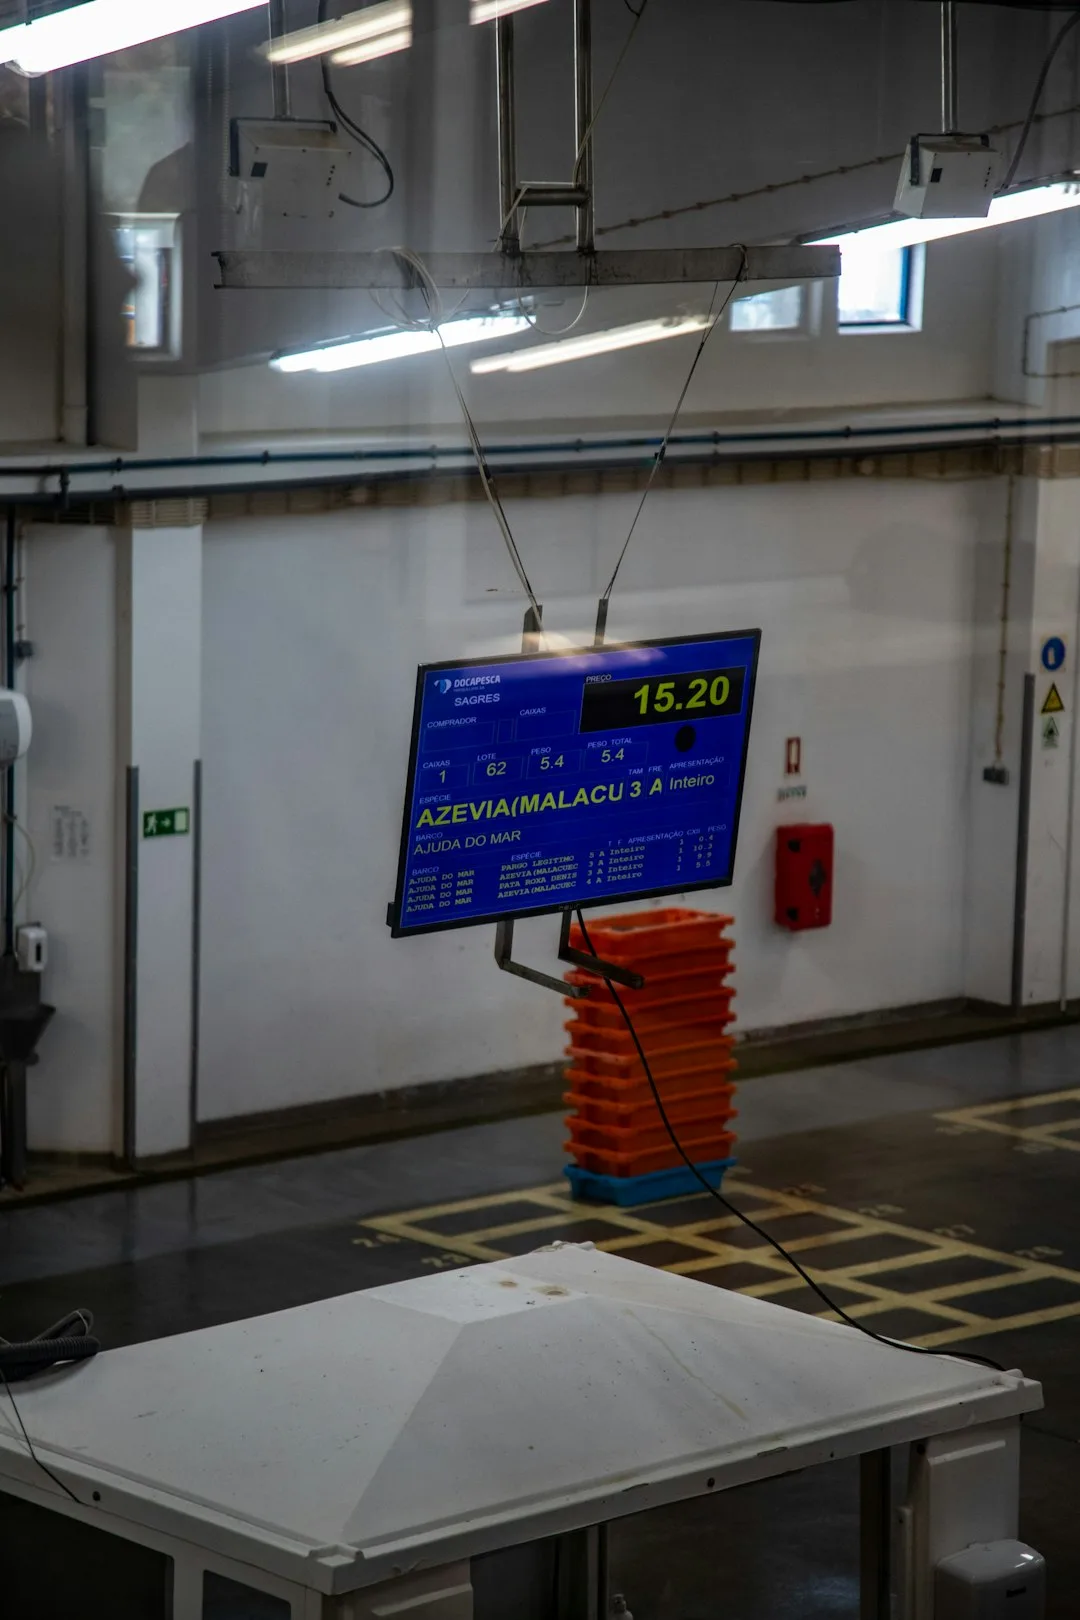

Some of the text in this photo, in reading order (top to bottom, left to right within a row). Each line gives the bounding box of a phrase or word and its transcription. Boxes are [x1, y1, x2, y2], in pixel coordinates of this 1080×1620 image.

[454, 675, 500, 688] DOCAPESCA
[586, 674, 612, 683] PREÇO
[454, 693, 500, 706] SAGRES
[634, 676, 730, 714] 15.20
[520, 707, 546, 716] CAIXAS
[427, 717, 476, 728] COMPRADOR
[588, 740, 607, 748] PESO
[531, 747, 551, 755] PESO
[601, 748, 624, 764] 5.4
[477, 753, 496, 762] LOTE
[540, 755, 564, 770] 5.4
[423, 760, 450, 768] CAIXAS
[486, 762, 506, 776] 62
[439, 770, 446, 784] 1
[416, 774, 714, 828] AZEVIA(MALACU 3 A Inteiro
[419, 794, 450, 804] ESPÉCIE
[414, 830, 521, 855] AJUDA DO MAR
[416, 832, 442, 842] BARCO
[610, 845, 645, 856] Inteiro
[501, 856, 574, 872] PARGO LEGITIMO
[609, 854, 644, 864] Inteiro
[412, 866, 439, 876] BARCO
[608, 862, 644, 873] Inteiro
[409, 876, 437, 886] AJUDA
[458, 870, 474, 878] MAR
[499, 872, 577, 890] PATA ROXA DENIS
[607, 872, 642, 882] Inteiro
[408, 885, 436, 894] AJUDA
[457, 879, 474, 887] MAR
[406, 903, 434, 912] AJUDA
[454, 897, 472, 905] MAR
[408, 894, 435, 904] AJUDA
